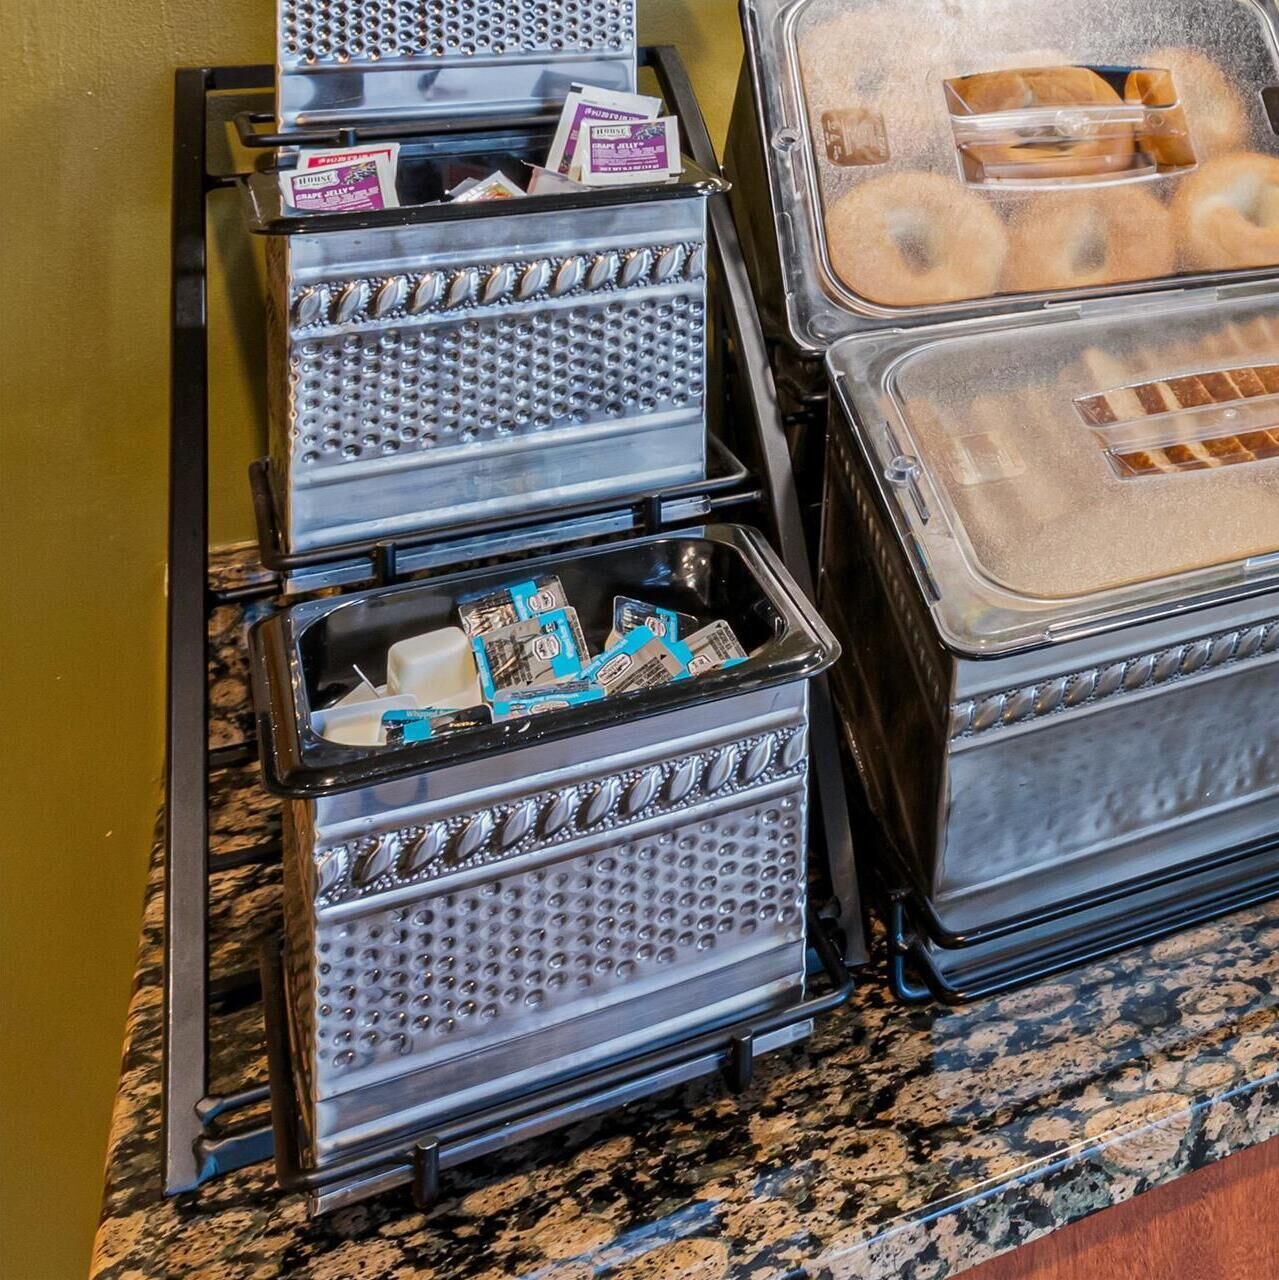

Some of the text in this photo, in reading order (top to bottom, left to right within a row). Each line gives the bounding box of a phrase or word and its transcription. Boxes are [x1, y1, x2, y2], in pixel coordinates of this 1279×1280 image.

[592, 141, 641, 150] GRAPE JELLY
[295, 186, 348, 200] GRAPE JELLY
